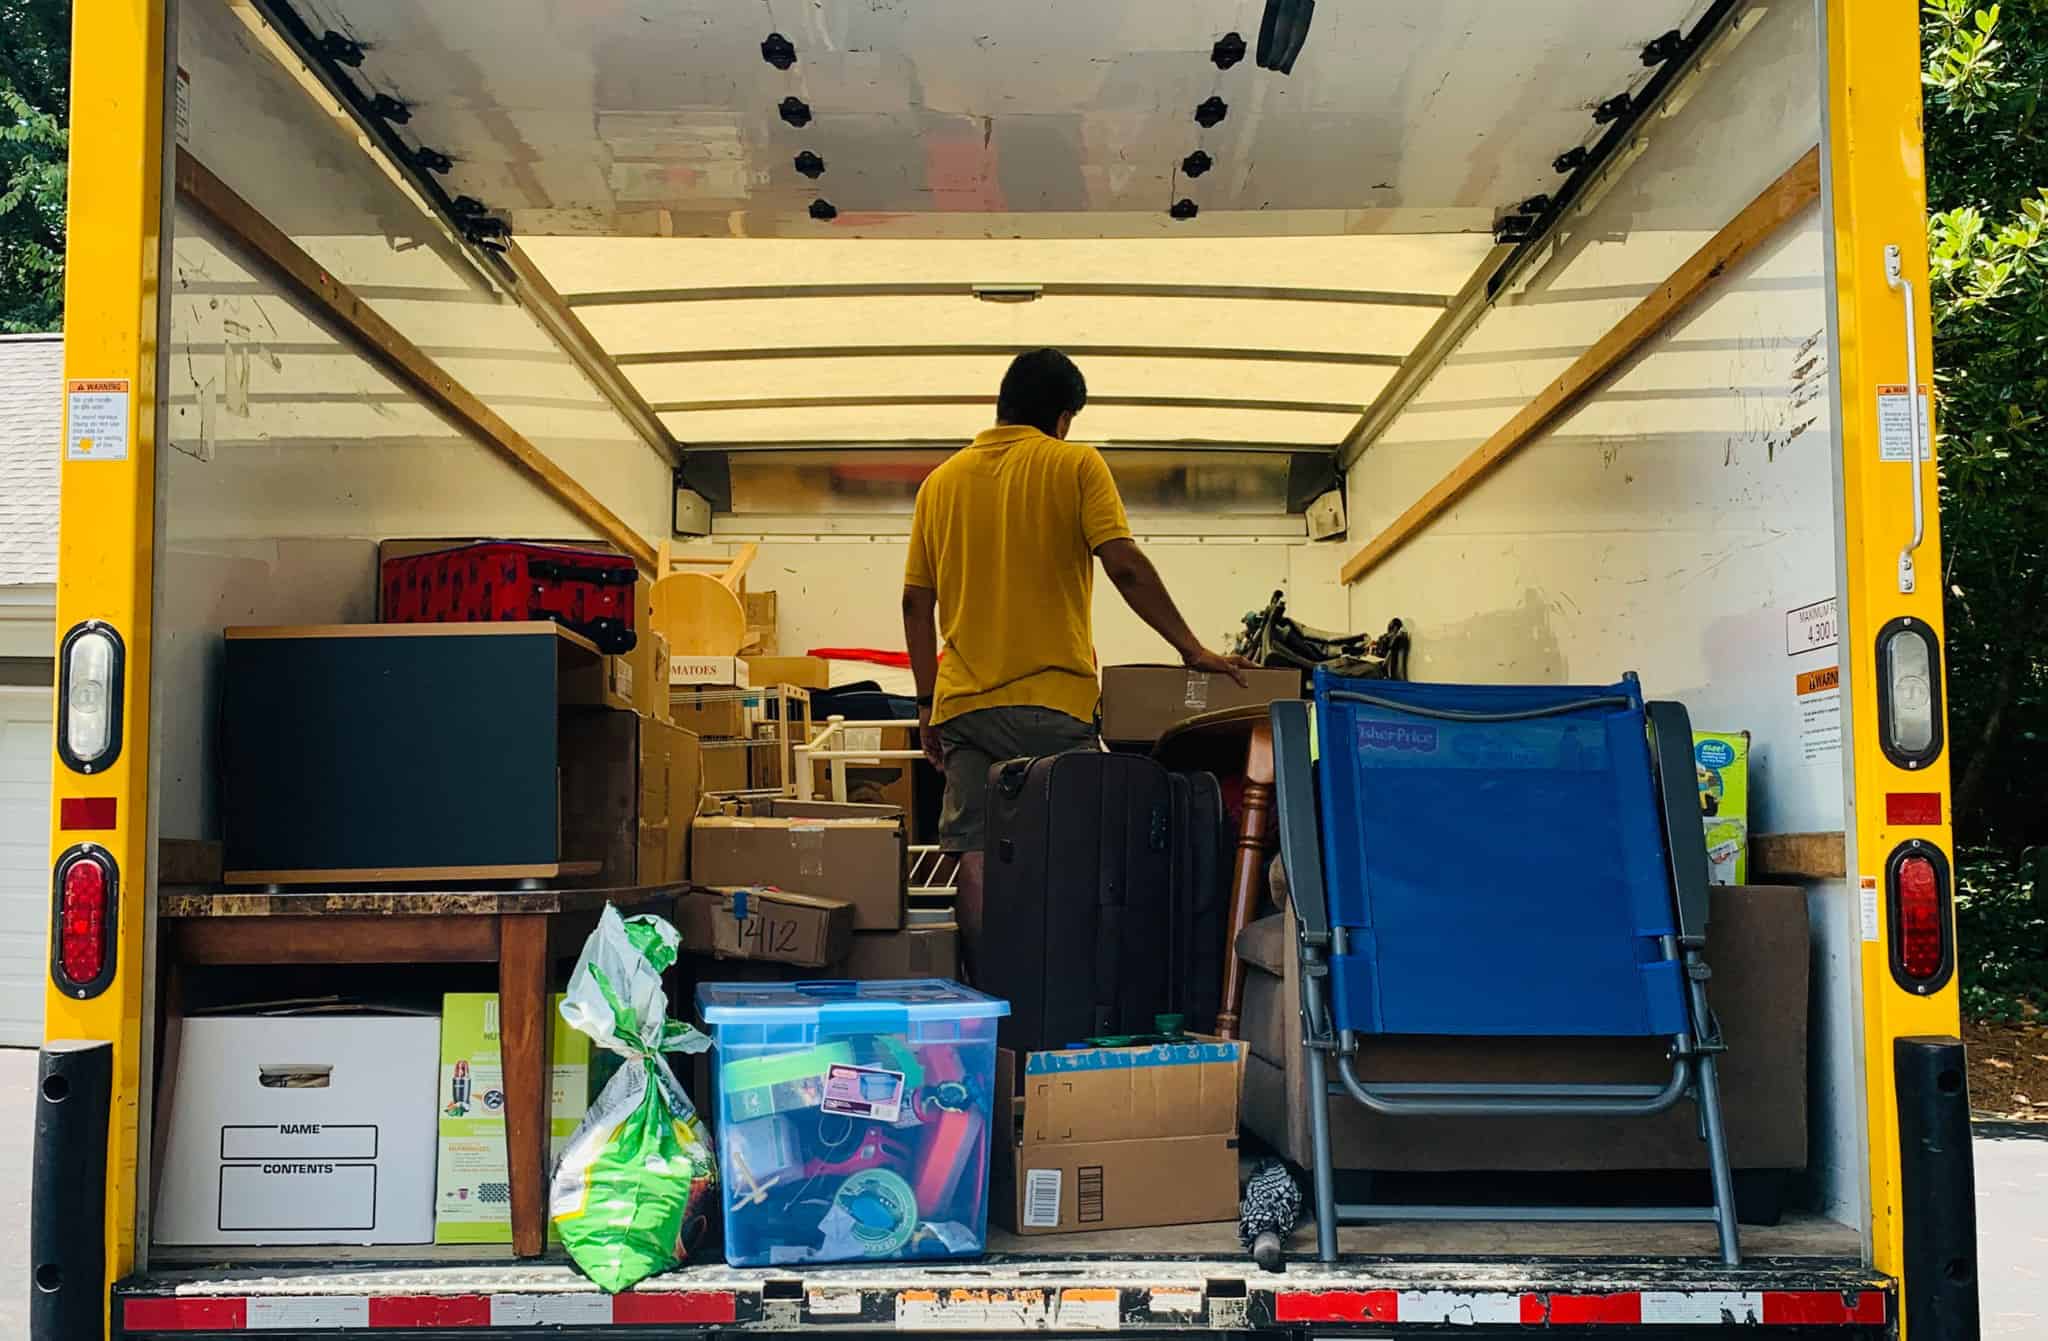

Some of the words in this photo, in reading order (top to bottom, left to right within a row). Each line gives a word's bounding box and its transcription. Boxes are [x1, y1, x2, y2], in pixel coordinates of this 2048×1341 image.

[87, 383, 121, 391] WARNING
[1799, 602, 1832, 623] MAXIMUM
[1808, 621, 1830, 645] 4,300
[671, 664, 717, 676] MATOES
[280, 1124, 320, 1135] NAME
[263, 1164, 333, 1174] CONTENTS
